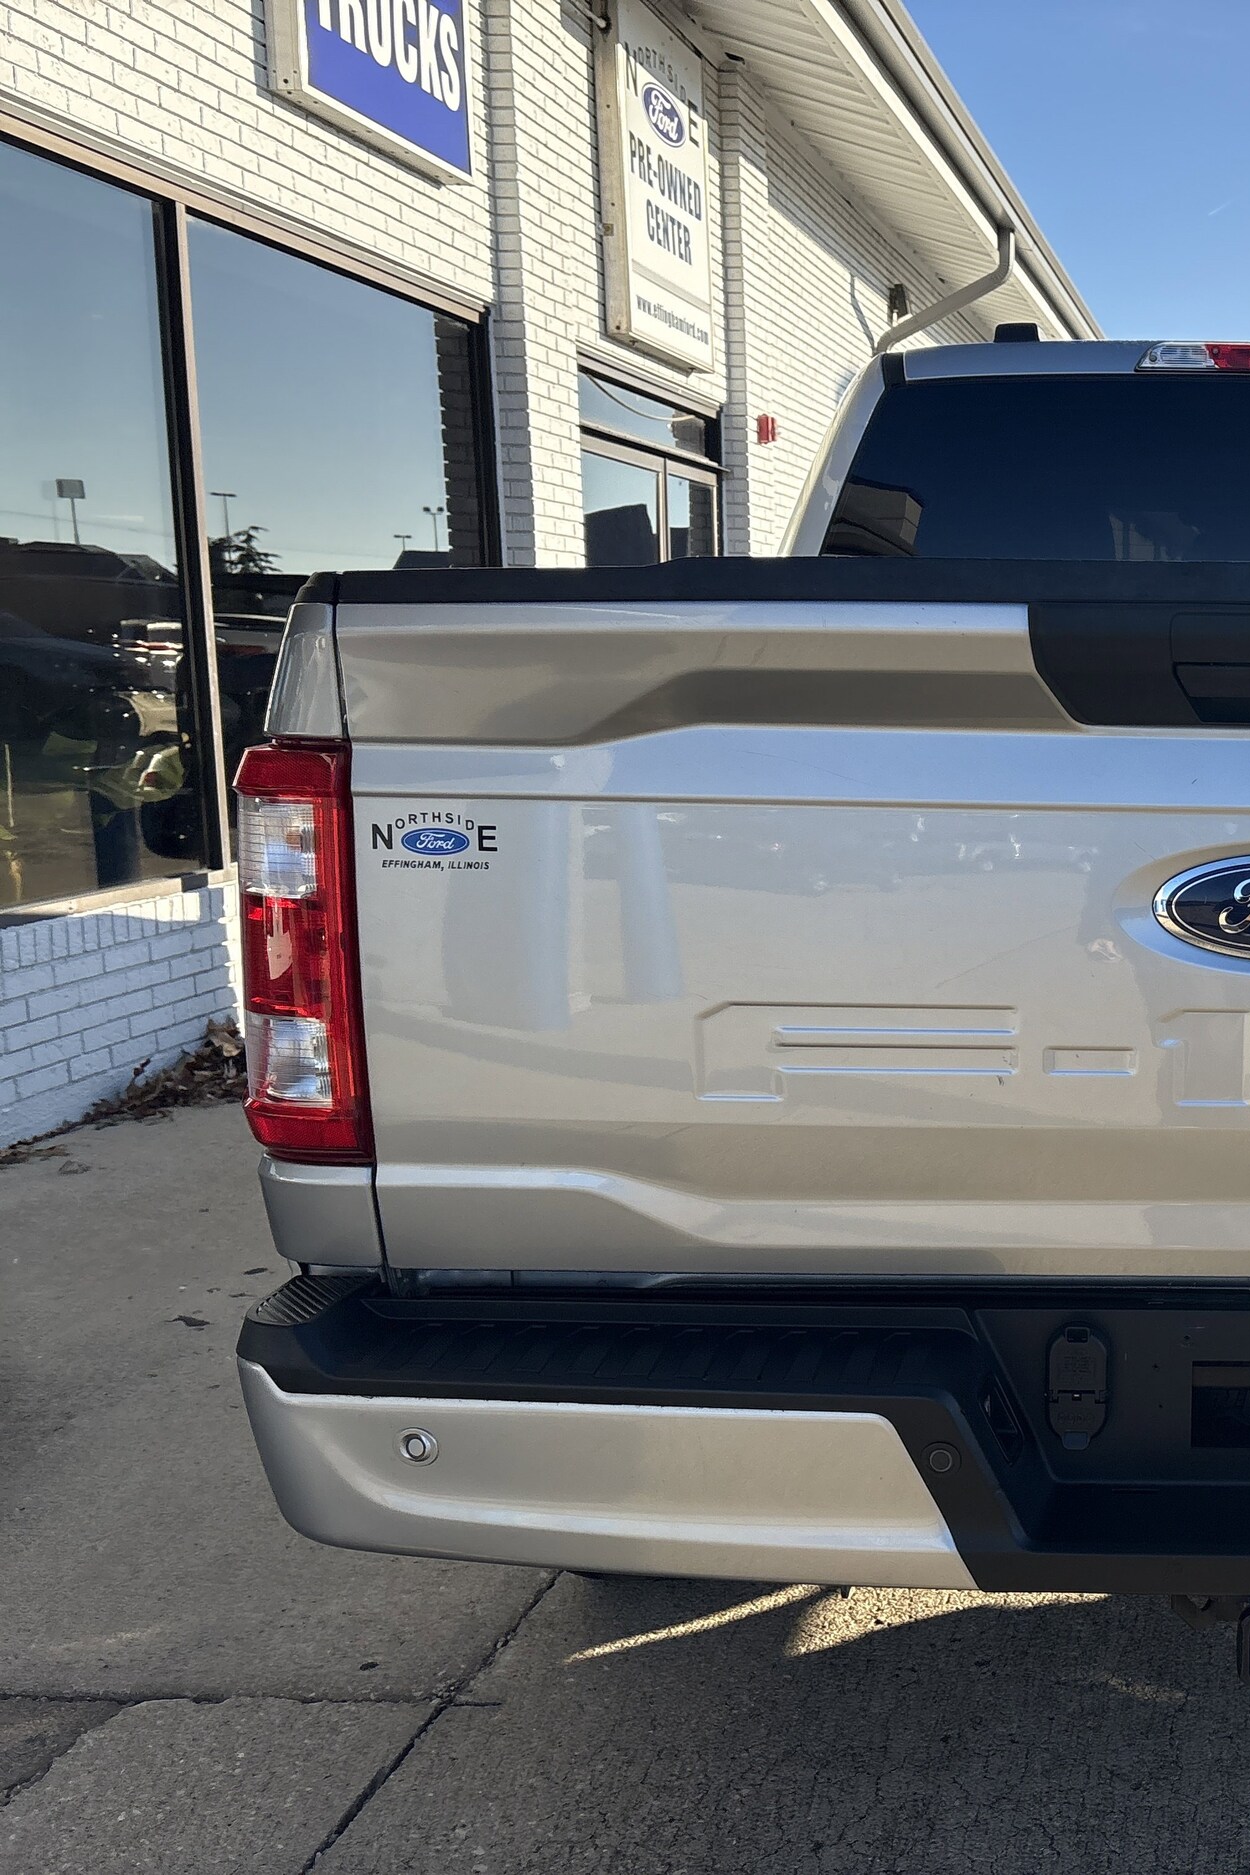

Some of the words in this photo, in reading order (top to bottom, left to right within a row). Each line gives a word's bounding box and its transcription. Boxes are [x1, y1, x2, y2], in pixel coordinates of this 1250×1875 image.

[624, 41, 701, 148] NORTHSIDE
[628, 130, 702, 222] PRE-OWNED
[646, 198, 692, 266] CENTER
[636, 293, 710, 346] www.effinghamford.com
[371, 812, 499, 852] NORTHSIDE
[381, 859, 445, 872] EFFINGHAM,
[448, 860, 490, 870] ILLINOIS
